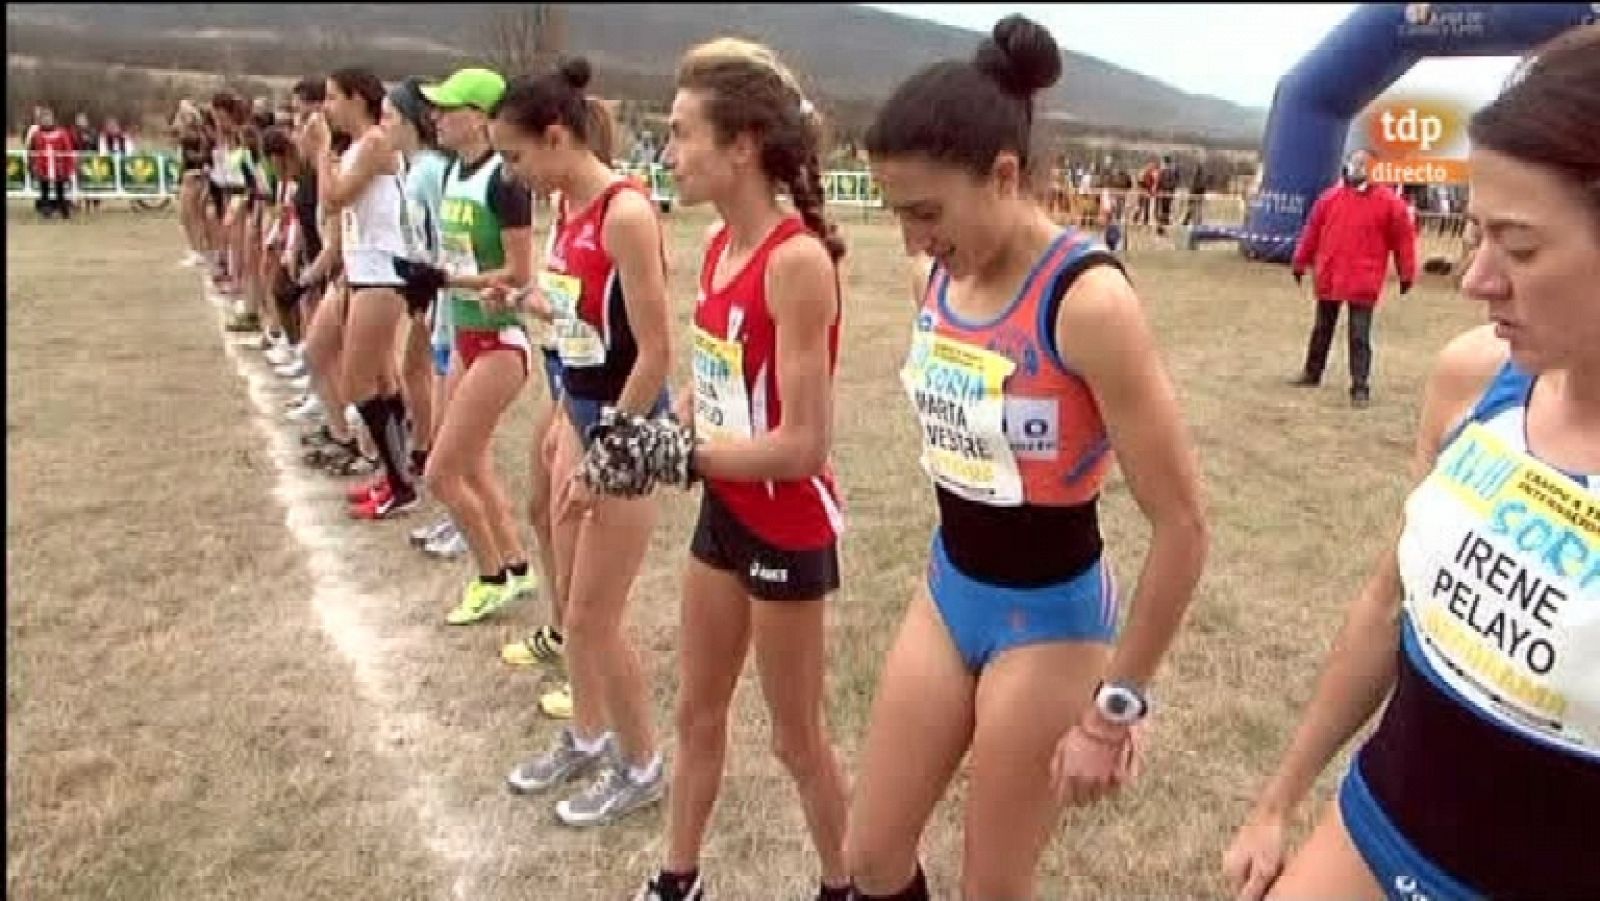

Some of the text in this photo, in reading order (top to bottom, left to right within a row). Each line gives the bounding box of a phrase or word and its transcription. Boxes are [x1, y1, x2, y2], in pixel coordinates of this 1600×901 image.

[914, 388, 968, 432] MARTA
[1432, 567, 1556, 675] PELAYO
[1454, 530, 1568, 628] IRENE
